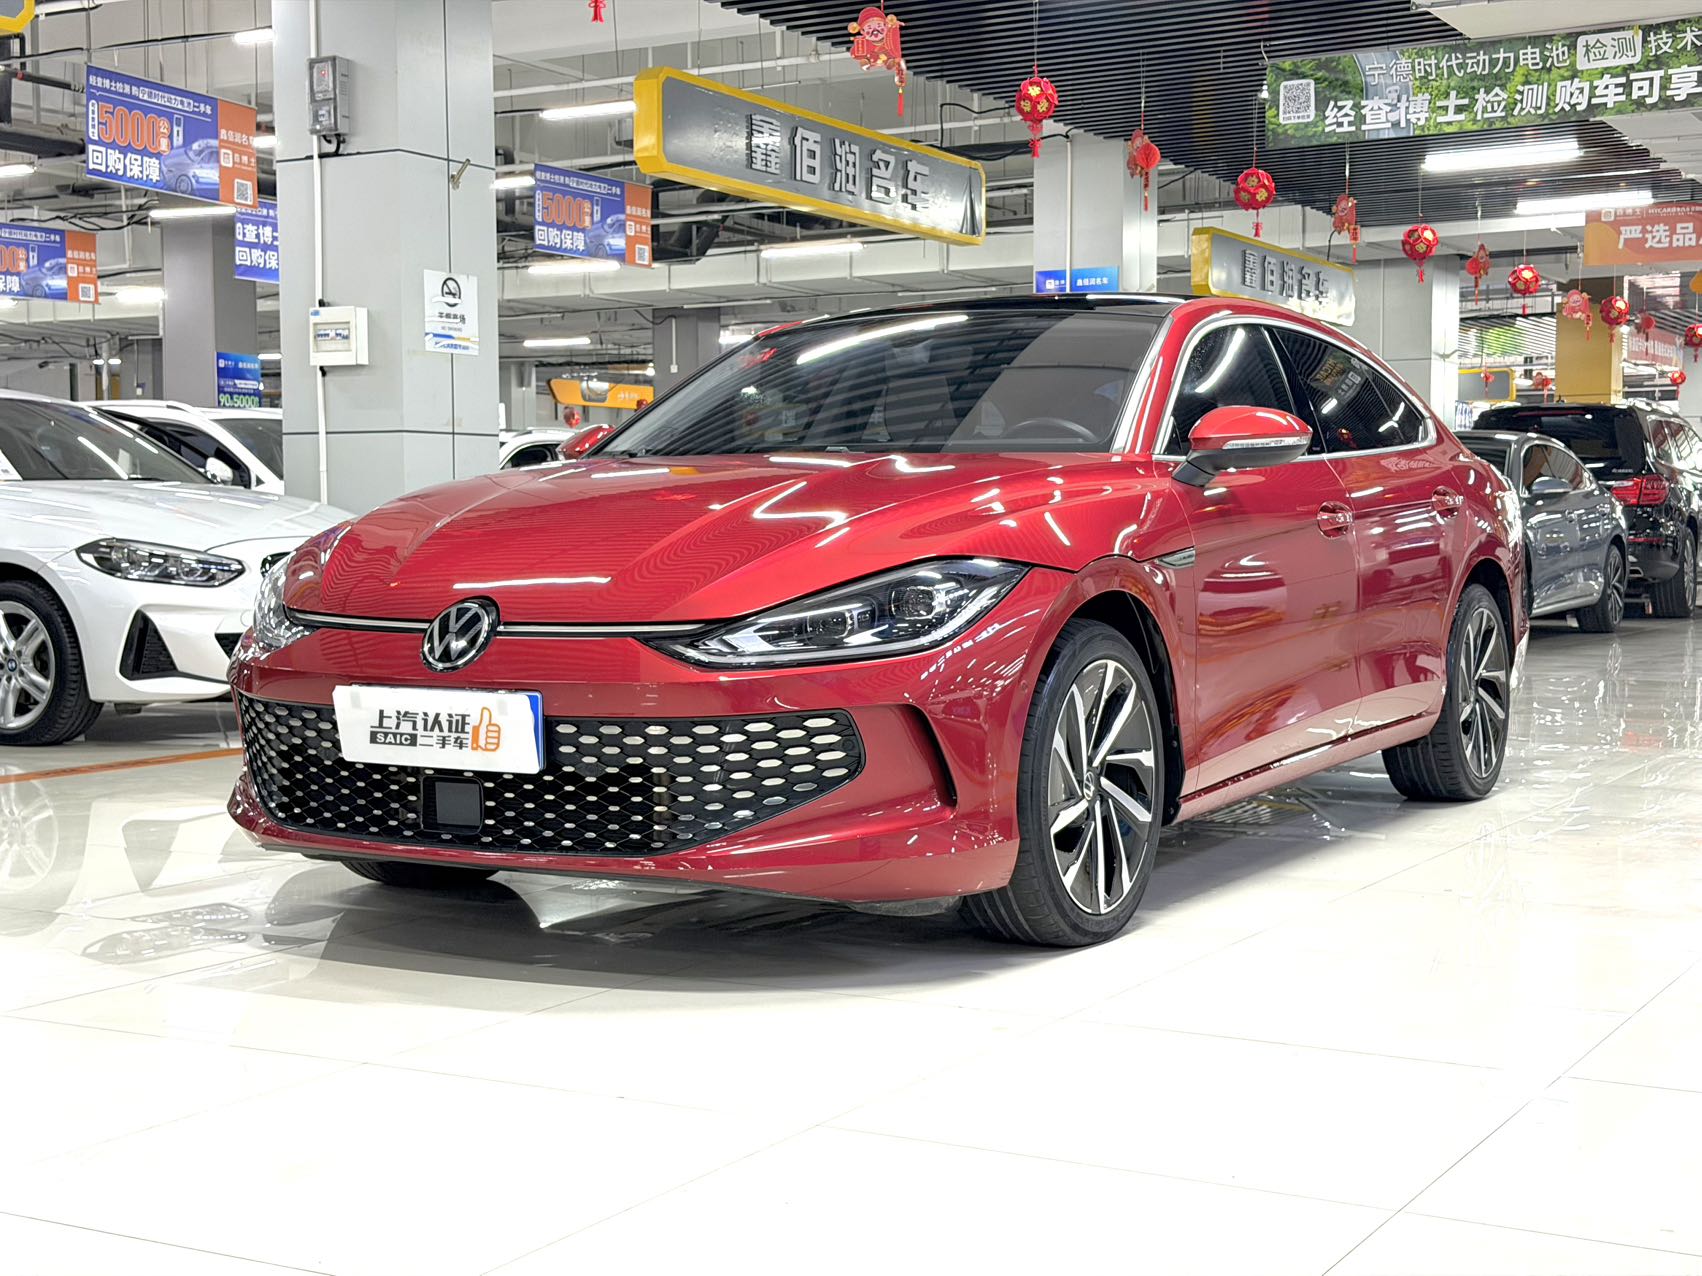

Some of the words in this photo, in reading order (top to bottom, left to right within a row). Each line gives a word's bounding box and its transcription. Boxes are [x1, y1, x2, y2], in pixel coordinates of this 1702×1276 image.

[1365, 42, 1571, 86] 宁德时代动力电池
[1582, 35, 1637, 64] 检测
[1648, 26, 1702, 57] 技术
[1324, 65, 1702, 133] 经查博士检测购车可享
[88, 144, 161, 183] 回购保障
[746, 113, 930, 212] 鑫佰润名车
[535, 225, 585, 252] 回购保障
[1618, 222, 1702, 249] 严选品
[235, 246, 279, 270] 回购保
[370, 709, 470, 734] 上汽认证
[376, 733, 411, 745] SAIC
[419, 734, 470, 750] 二手车
